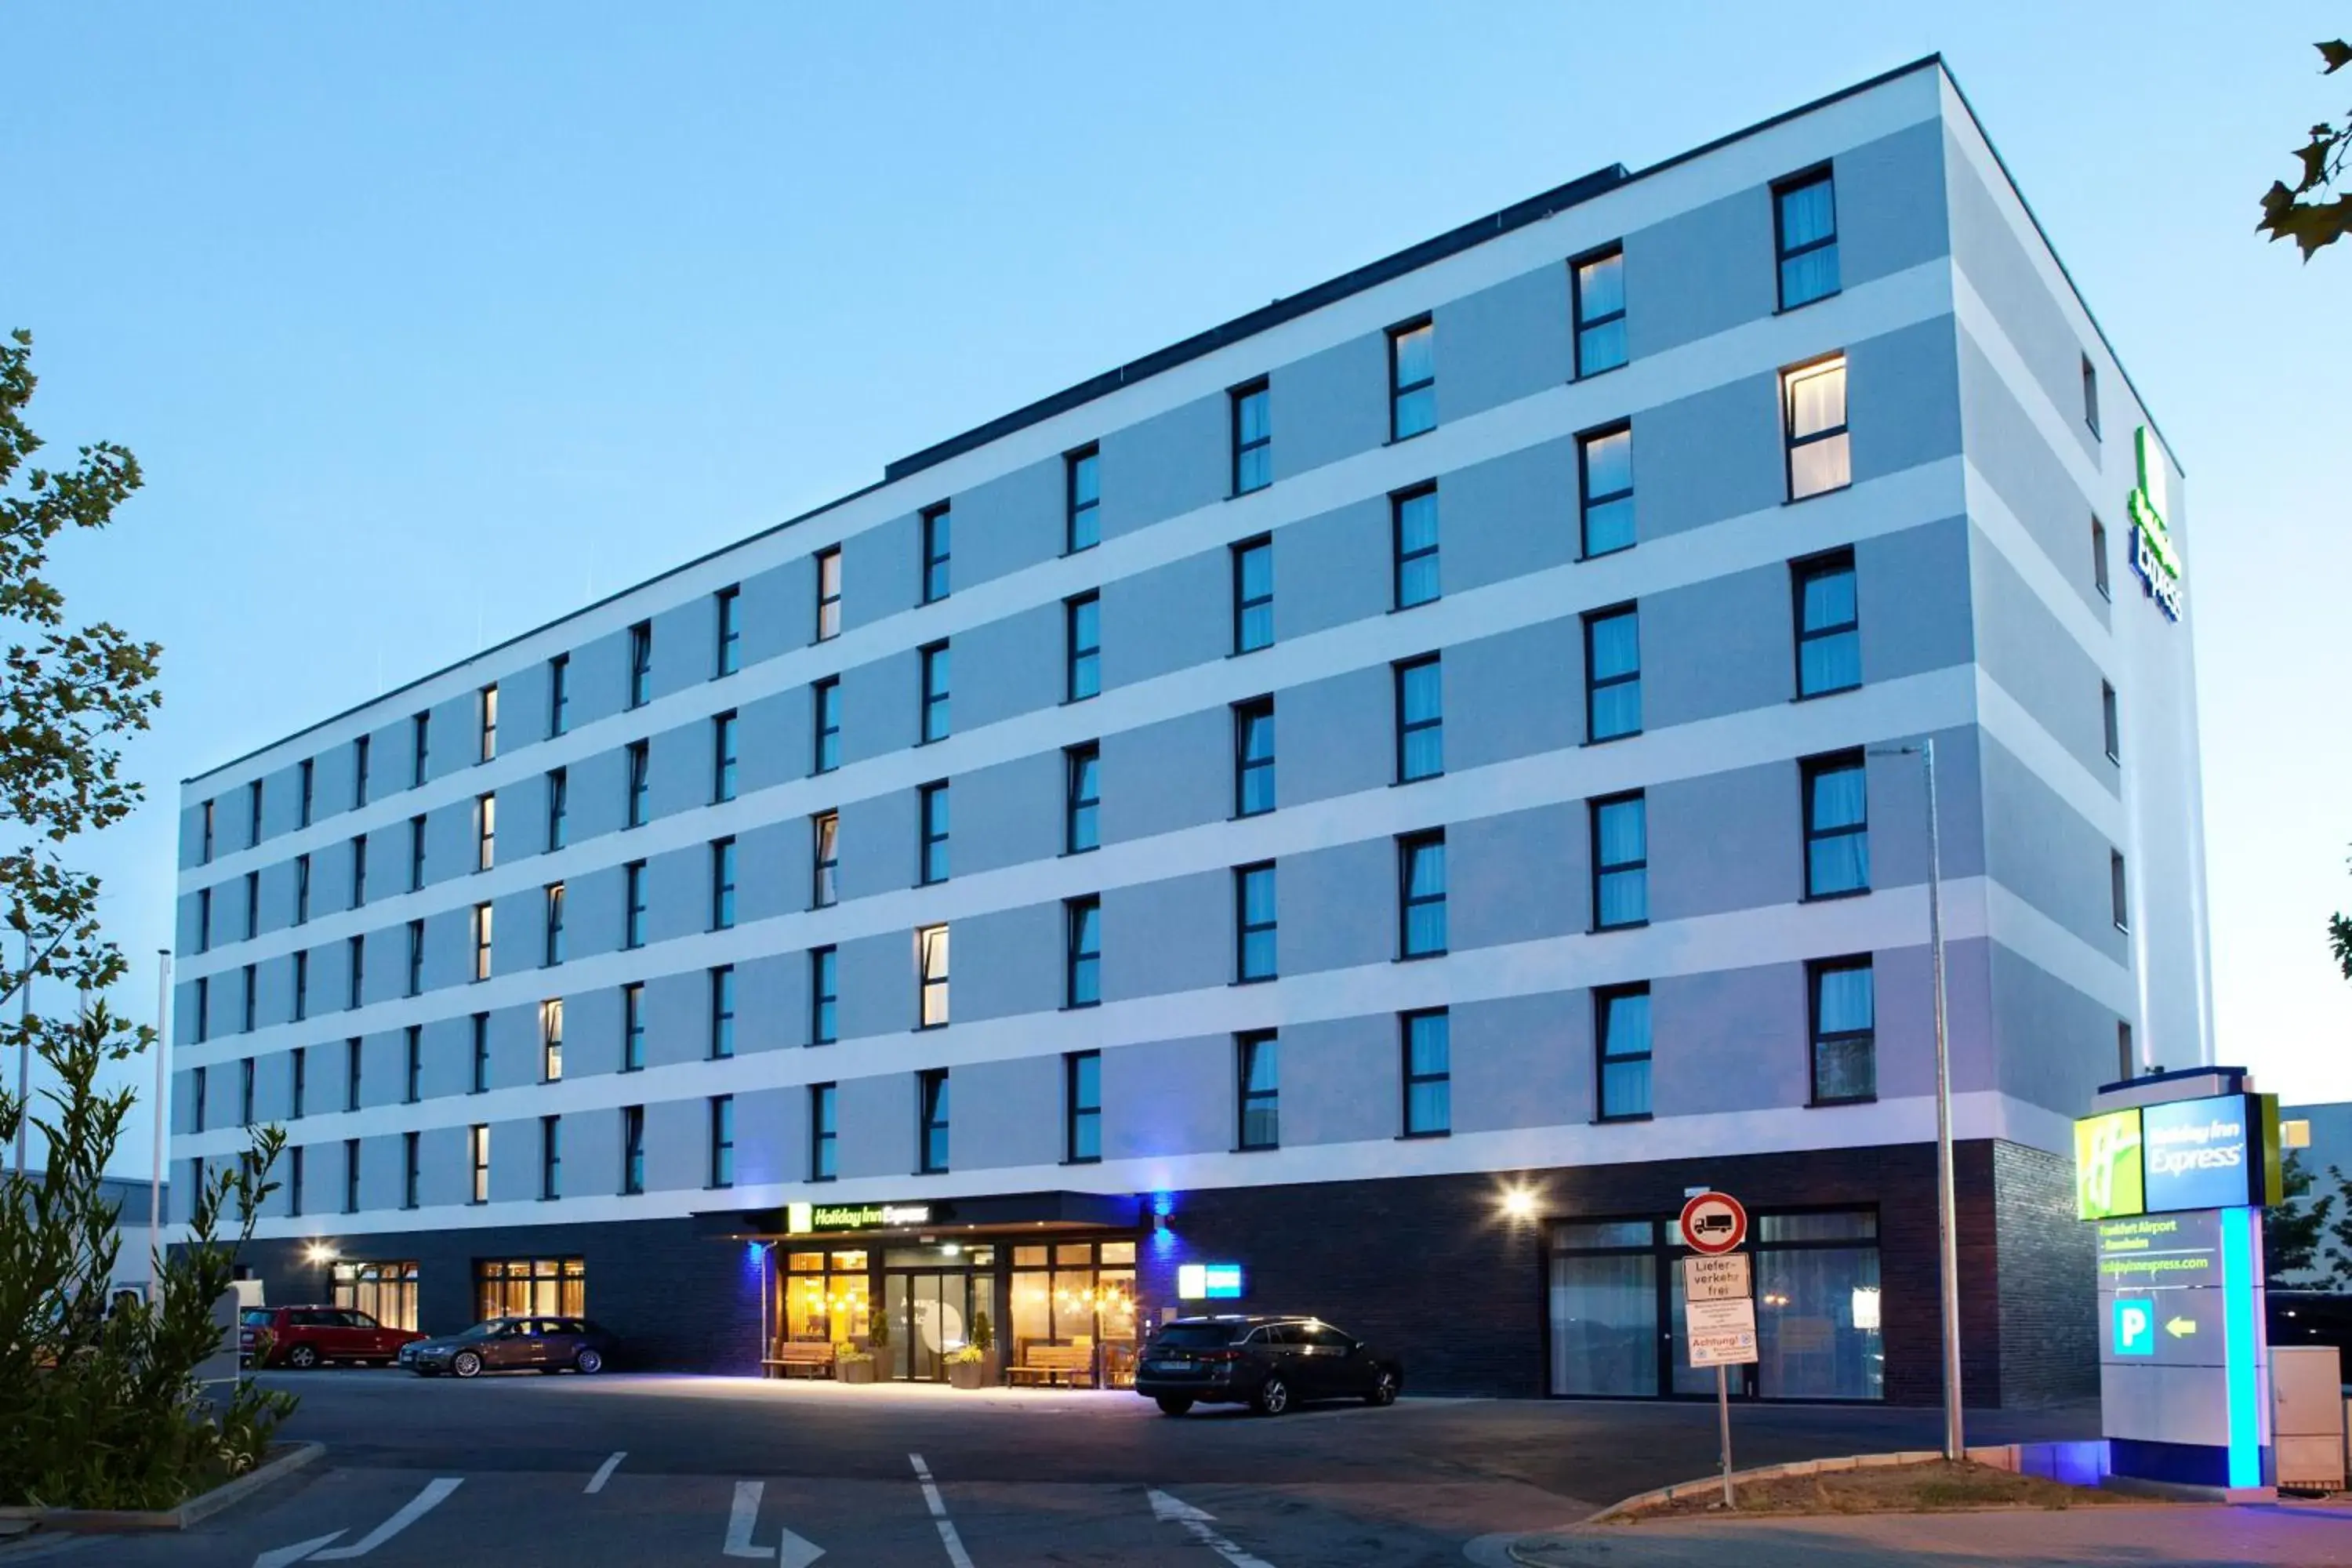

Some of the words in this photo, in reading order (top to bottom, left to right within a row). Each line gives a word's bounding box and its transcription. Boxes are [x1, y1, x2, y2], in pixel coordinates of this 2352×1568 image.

[2211, 1119, 2240, 1139] Inn
[2151, 1145, 2242, 1178] Express
[815, 1207, 861, 1227] Holiday
[862, 1205, 882, 1222] Inn
[2139, 1220, 2177, 1236] Airport
[1695, 1259, 1737, 1271] Liefer-
[1694, 1272, 1740, 1284] verkehr
[1708, 1284, 1730, 1296] frei
[1693, 1335, 1739, 1347] Achtung!
